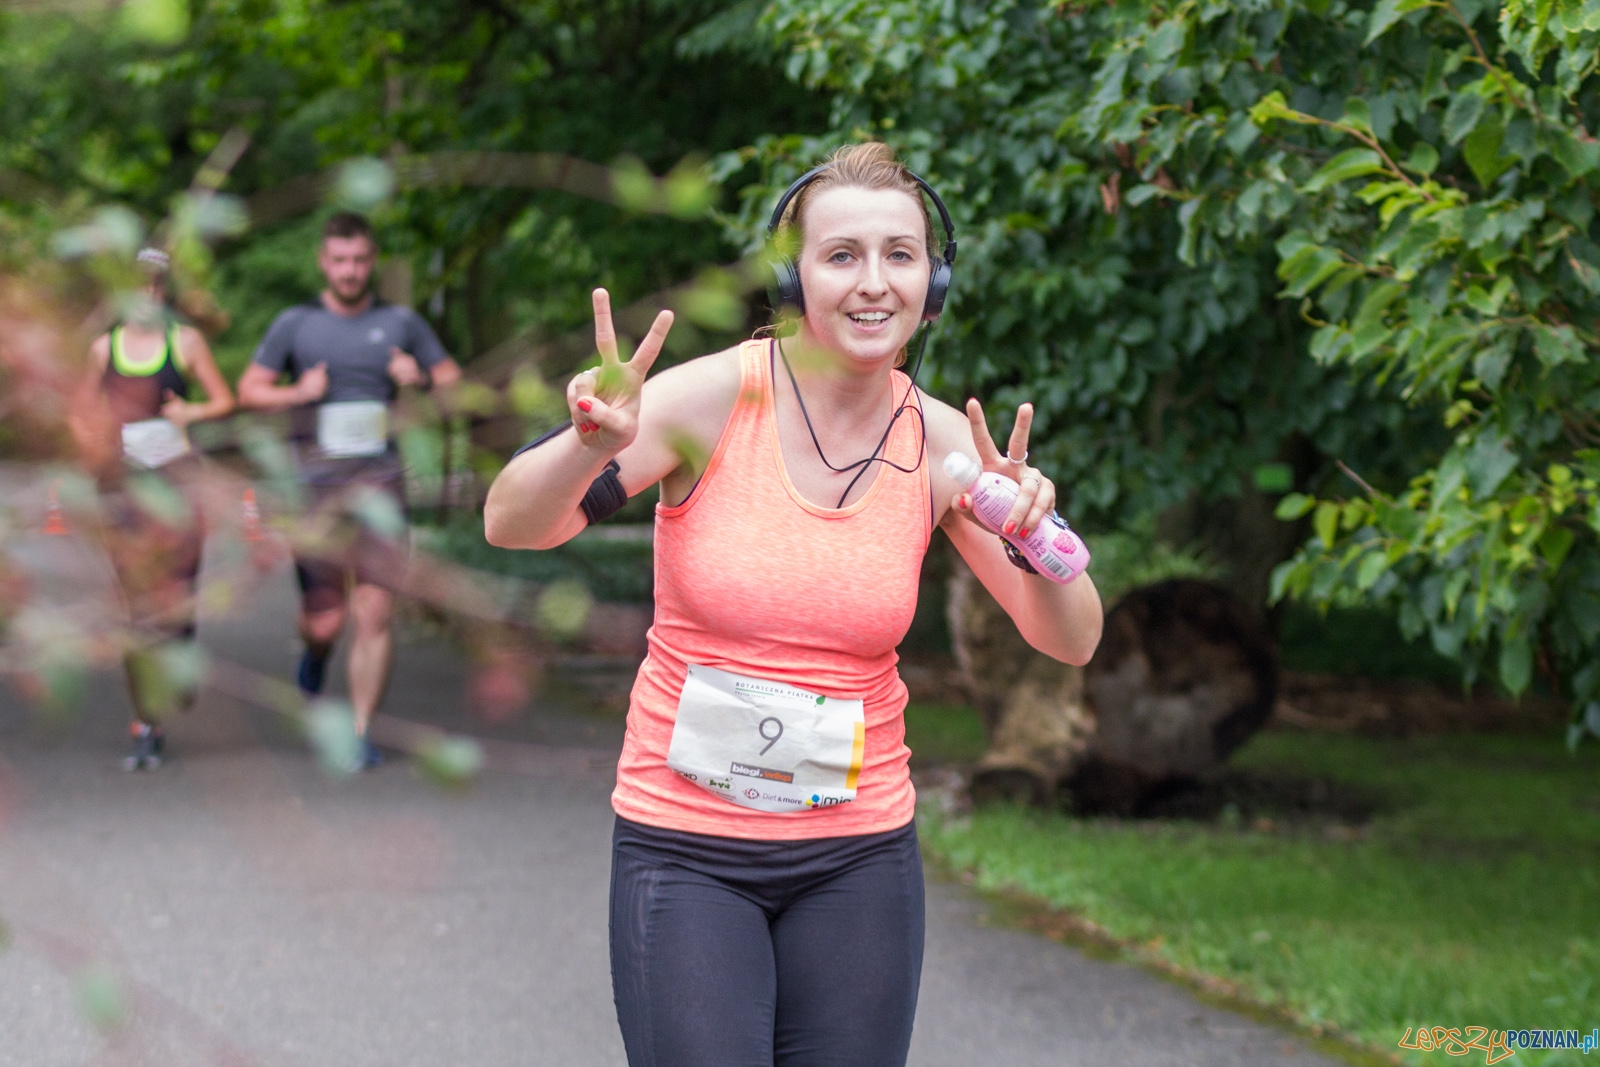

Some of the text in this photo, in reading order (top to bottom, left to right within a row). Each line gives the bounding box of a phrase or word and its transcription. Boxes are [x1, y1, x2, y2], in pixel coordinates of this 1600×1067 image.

[735, 682, 784, 694] BOTANICZNA
[787, 690, 814, 700] PIĄTKA
[758, 716, 784, 757] 9
[762, 792, 777, 801] Diet
[782, 797, 803, 805] more
